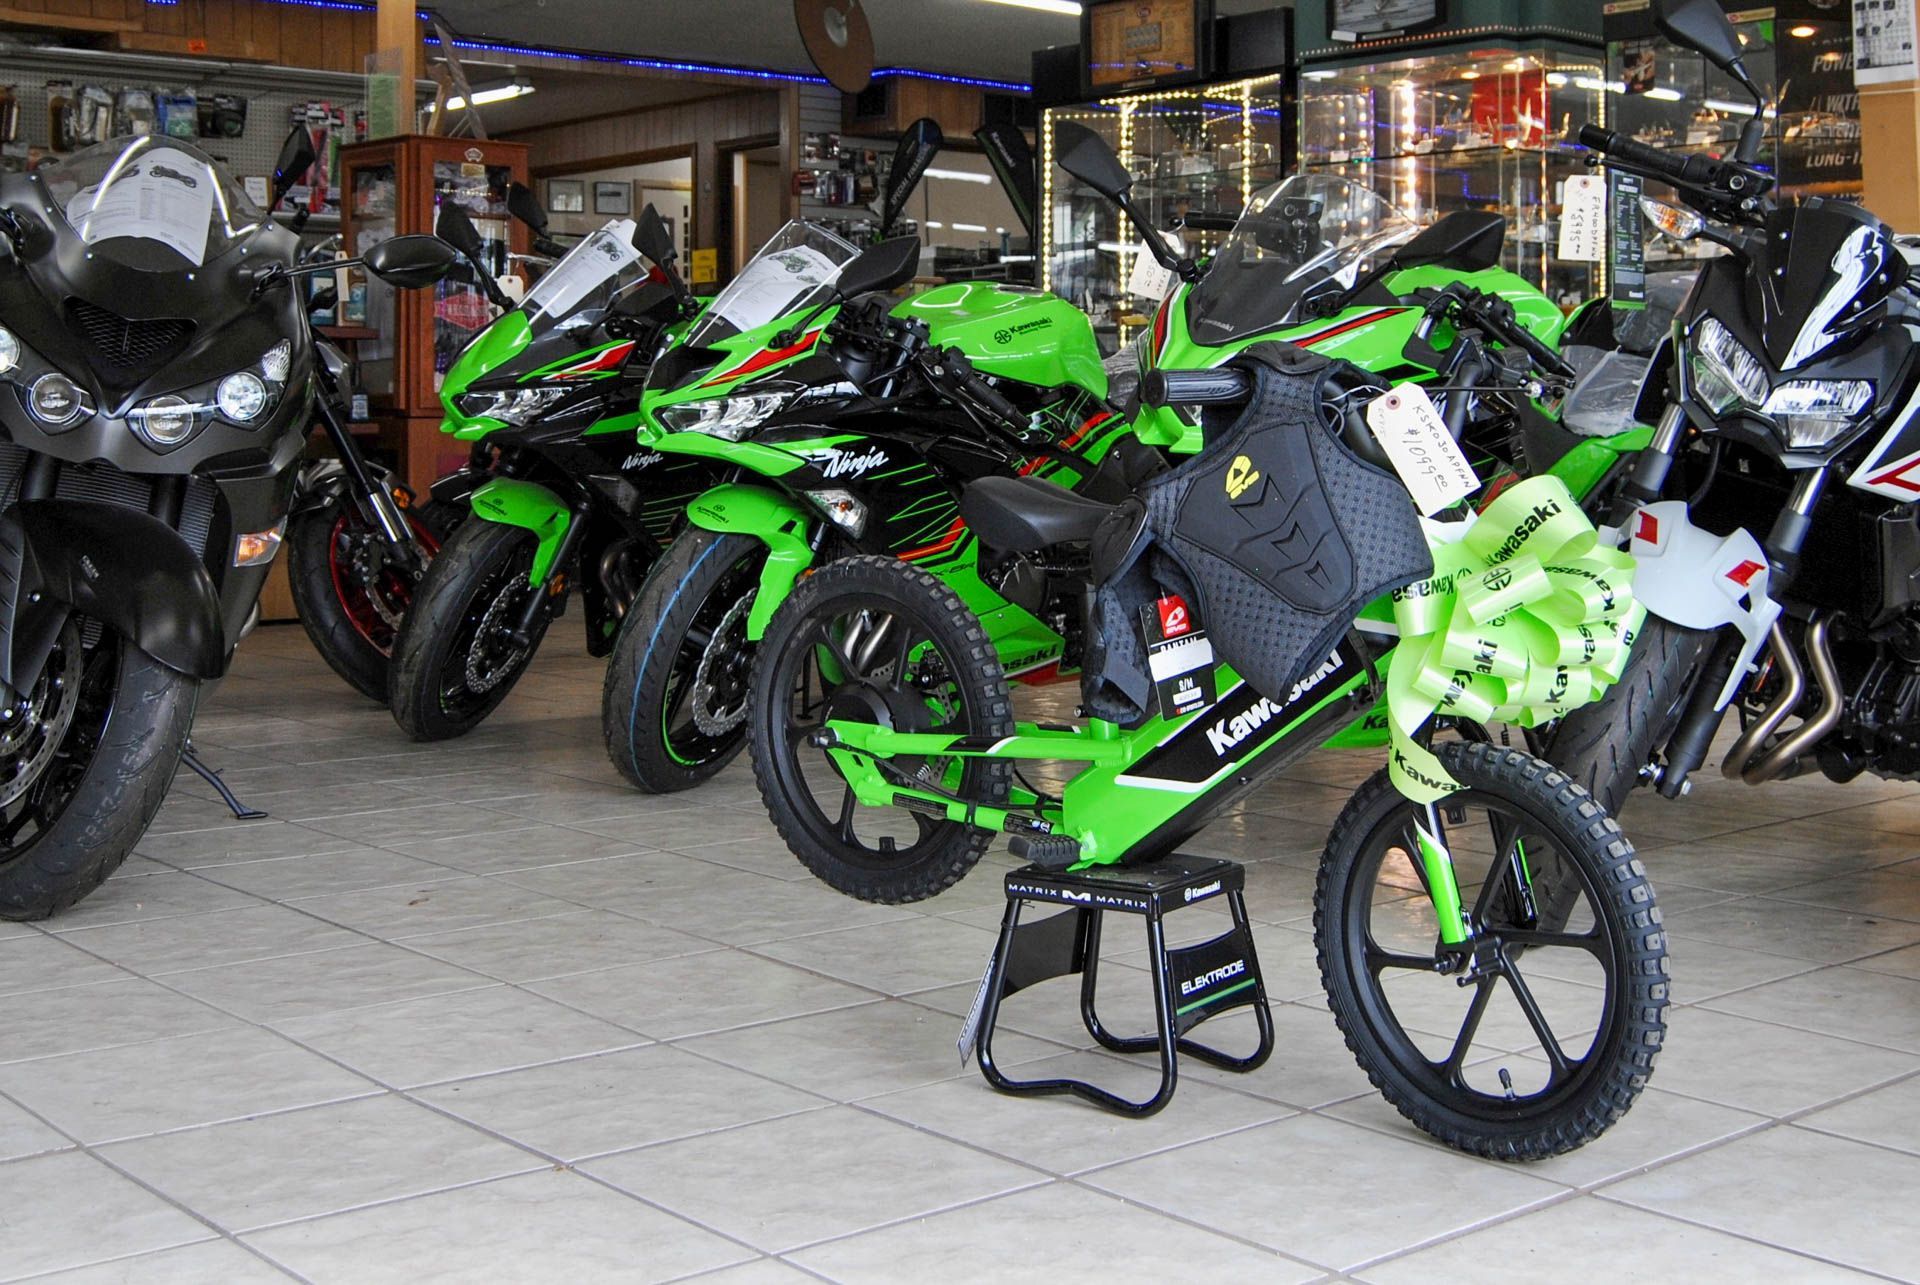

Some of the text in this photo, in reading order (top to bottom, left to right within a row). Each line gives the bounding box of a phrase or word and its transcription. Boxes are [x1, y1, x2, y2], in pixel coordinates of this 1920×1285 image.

[621, 450, 664, 470] Ninja
[822, 445, 890, 480] Ninja
[1486, 499, 1562, 567] Kawasaki
[1008, 883, 1057, 897] MATRIX
[1096, 895, 1147, 909] MATRIX
[1192, 880, 1221, 898] Kawasaki
[1181, 960, 1246, 996] ELEKTRODE
